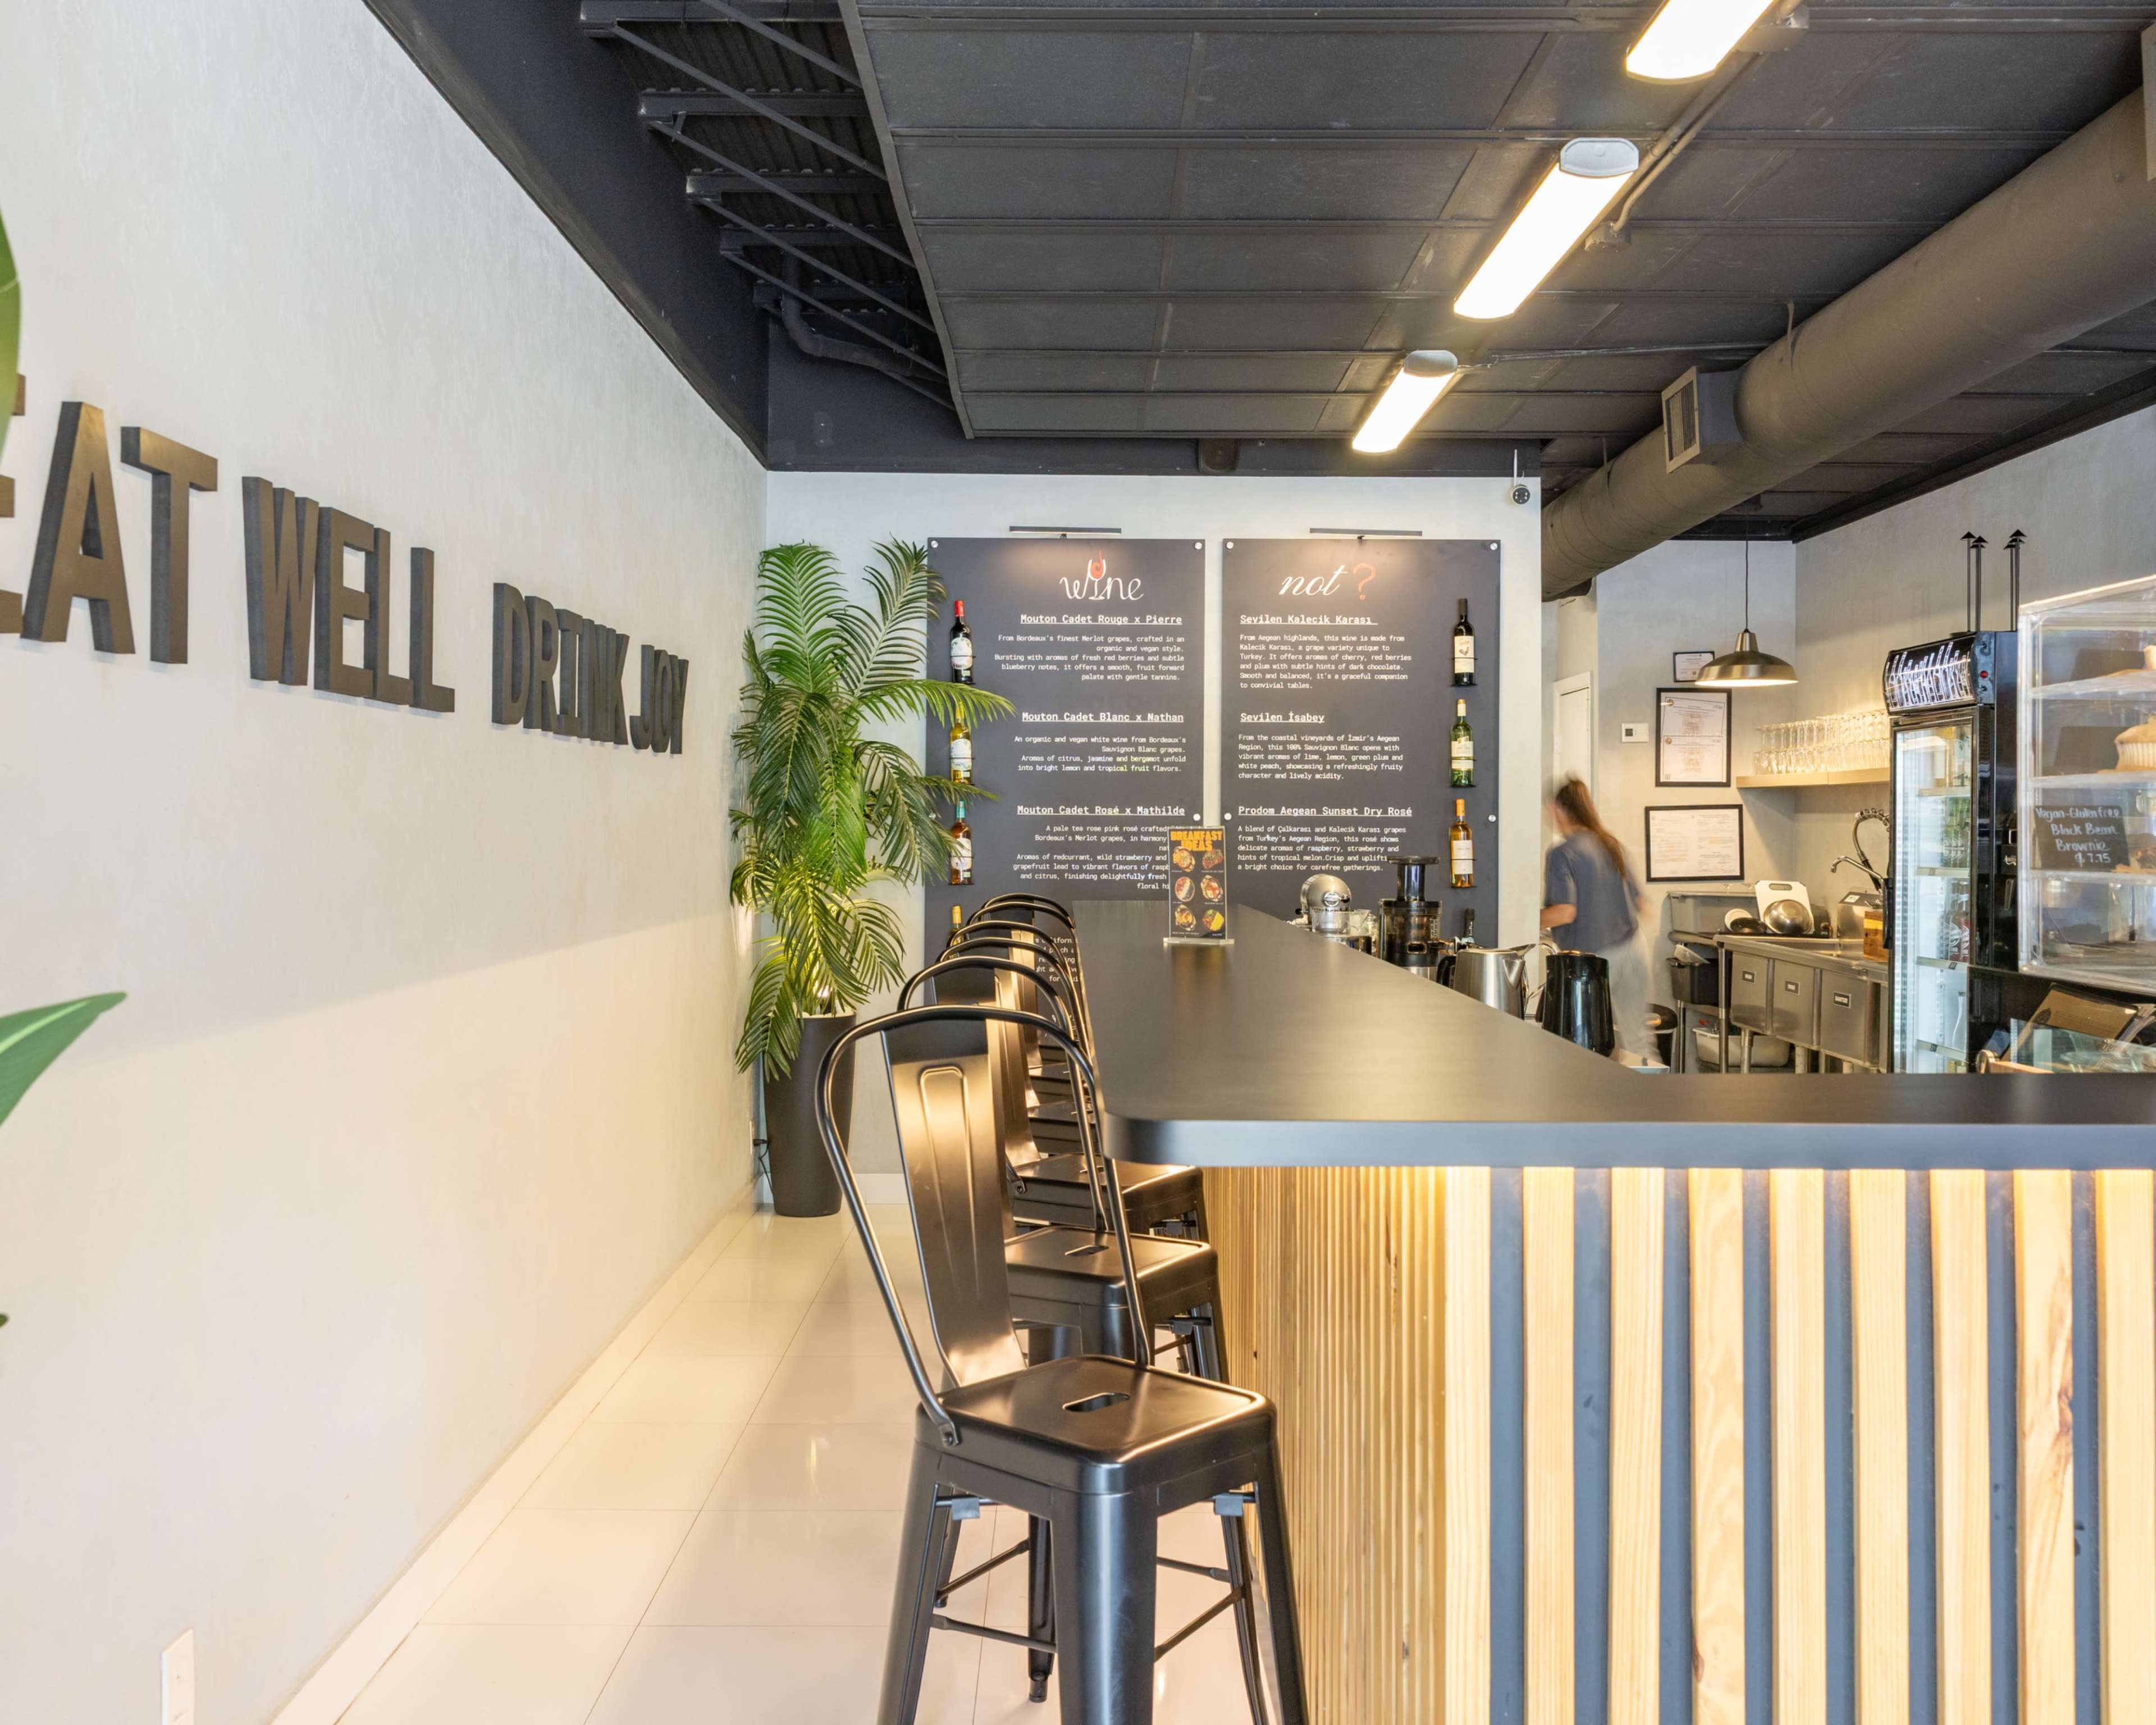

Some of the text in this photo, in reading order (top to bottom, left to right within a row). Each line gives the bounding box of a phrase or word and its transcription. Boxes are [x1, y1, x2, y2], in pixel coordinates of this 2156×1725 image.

[1059, 550, 1144, 600] wine
[1278, 564, 1348, 596] not
[242, 476, 455, 713] WELL
[491, 582, 630, 745] DRINK
[629, 644, 689, 754] JOY
[1021, 615, 1056, 623] Mouton
[1062, 615, 1091, 624] Cadet
[1098, 615, 1128, 626] Rouge
[1146, 615, 1182, 624] Pierre
[1241, 615, 1282, 624] Sevilen
[1288, 615, 1330, 624] Kalecik
[1022, 713, 1058, 722] Mouton
[1064, 713, 1094, 722] Cadet
[1100, 713, 1129, 722] Blanc
[1148, 713, 1183, 722] Nathan
[1241, 713, 1282, 722] Sevilen
[1017, 806, 1053, 814] Mouton
[1059, 806, 1089, 815] Cadet
[1137, 806, 1185, 815] Mathilde
[1239, 806, 1275, 815] Prodom
[1281, 806, 1316, 817] Aegean
[1323, 806, 1358, 815] Sunset
[1364, 807, 1382, 818] Dry
[2050, 823, 2119, 836] Black Bean
[1170, 830, 1222, 841] BREAKFAST
[2055, 838, 2111, 852] Brownie
